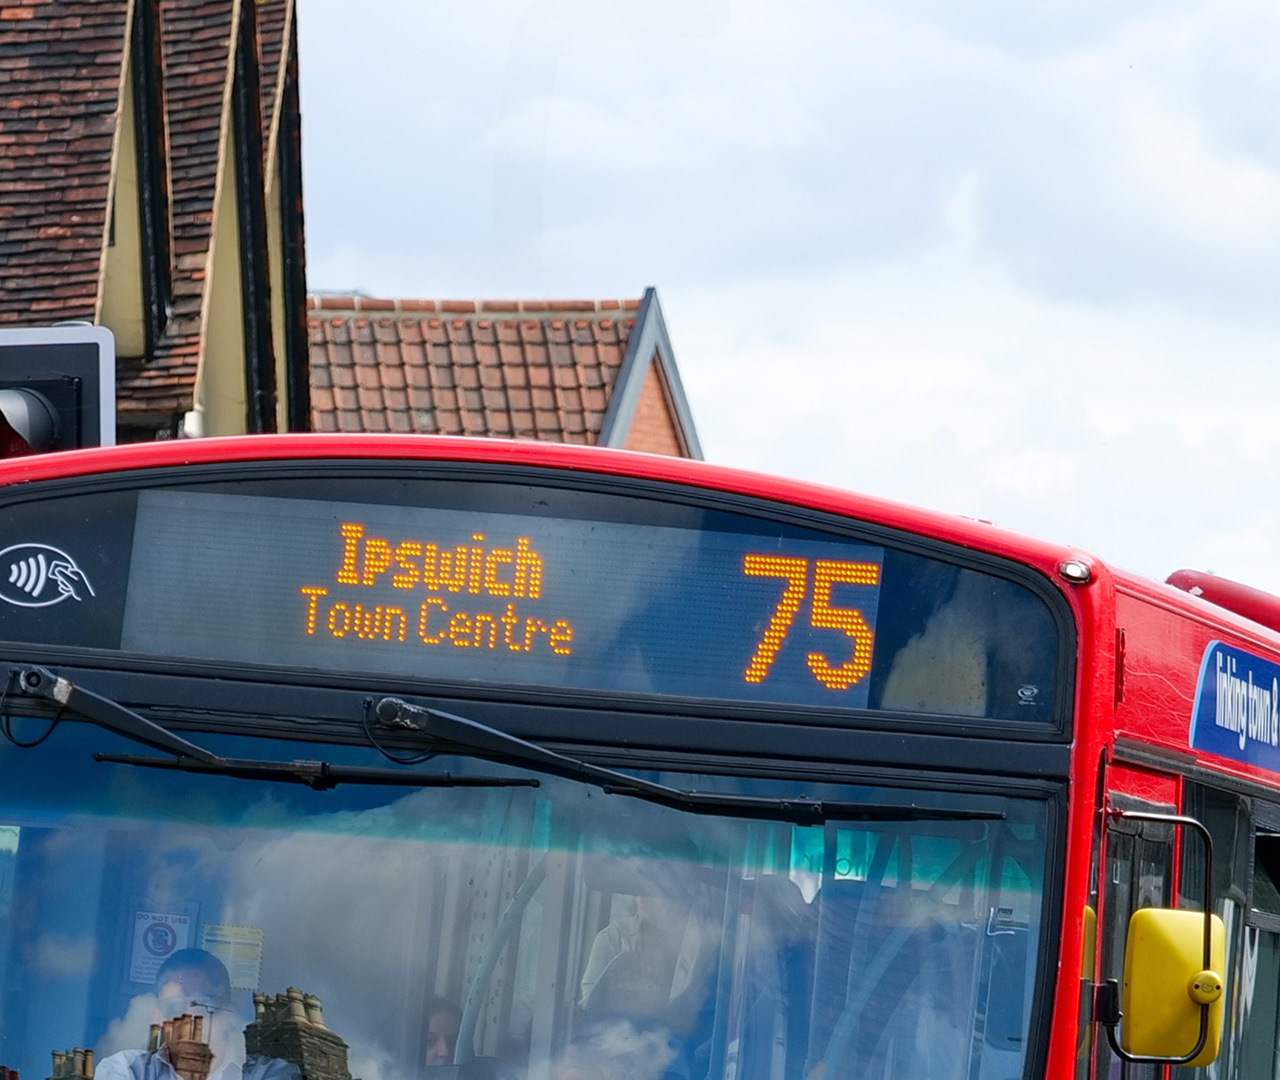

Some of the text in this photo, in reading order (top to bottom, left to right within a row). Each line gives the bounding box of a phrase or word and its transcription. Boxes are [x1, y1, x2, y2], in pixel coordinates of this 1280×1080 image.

[337, 523, 543, 599] Ipswich
[300, 587, 573, 655] Town Centre
[743, 554, 880, 690] 75
[1215, 651, 1247, 750] linking
[1248, 670, 1270, 744] town
[1271, 677, 1278, 747] &
[138, 913, 188, 925] DO NOT USE
